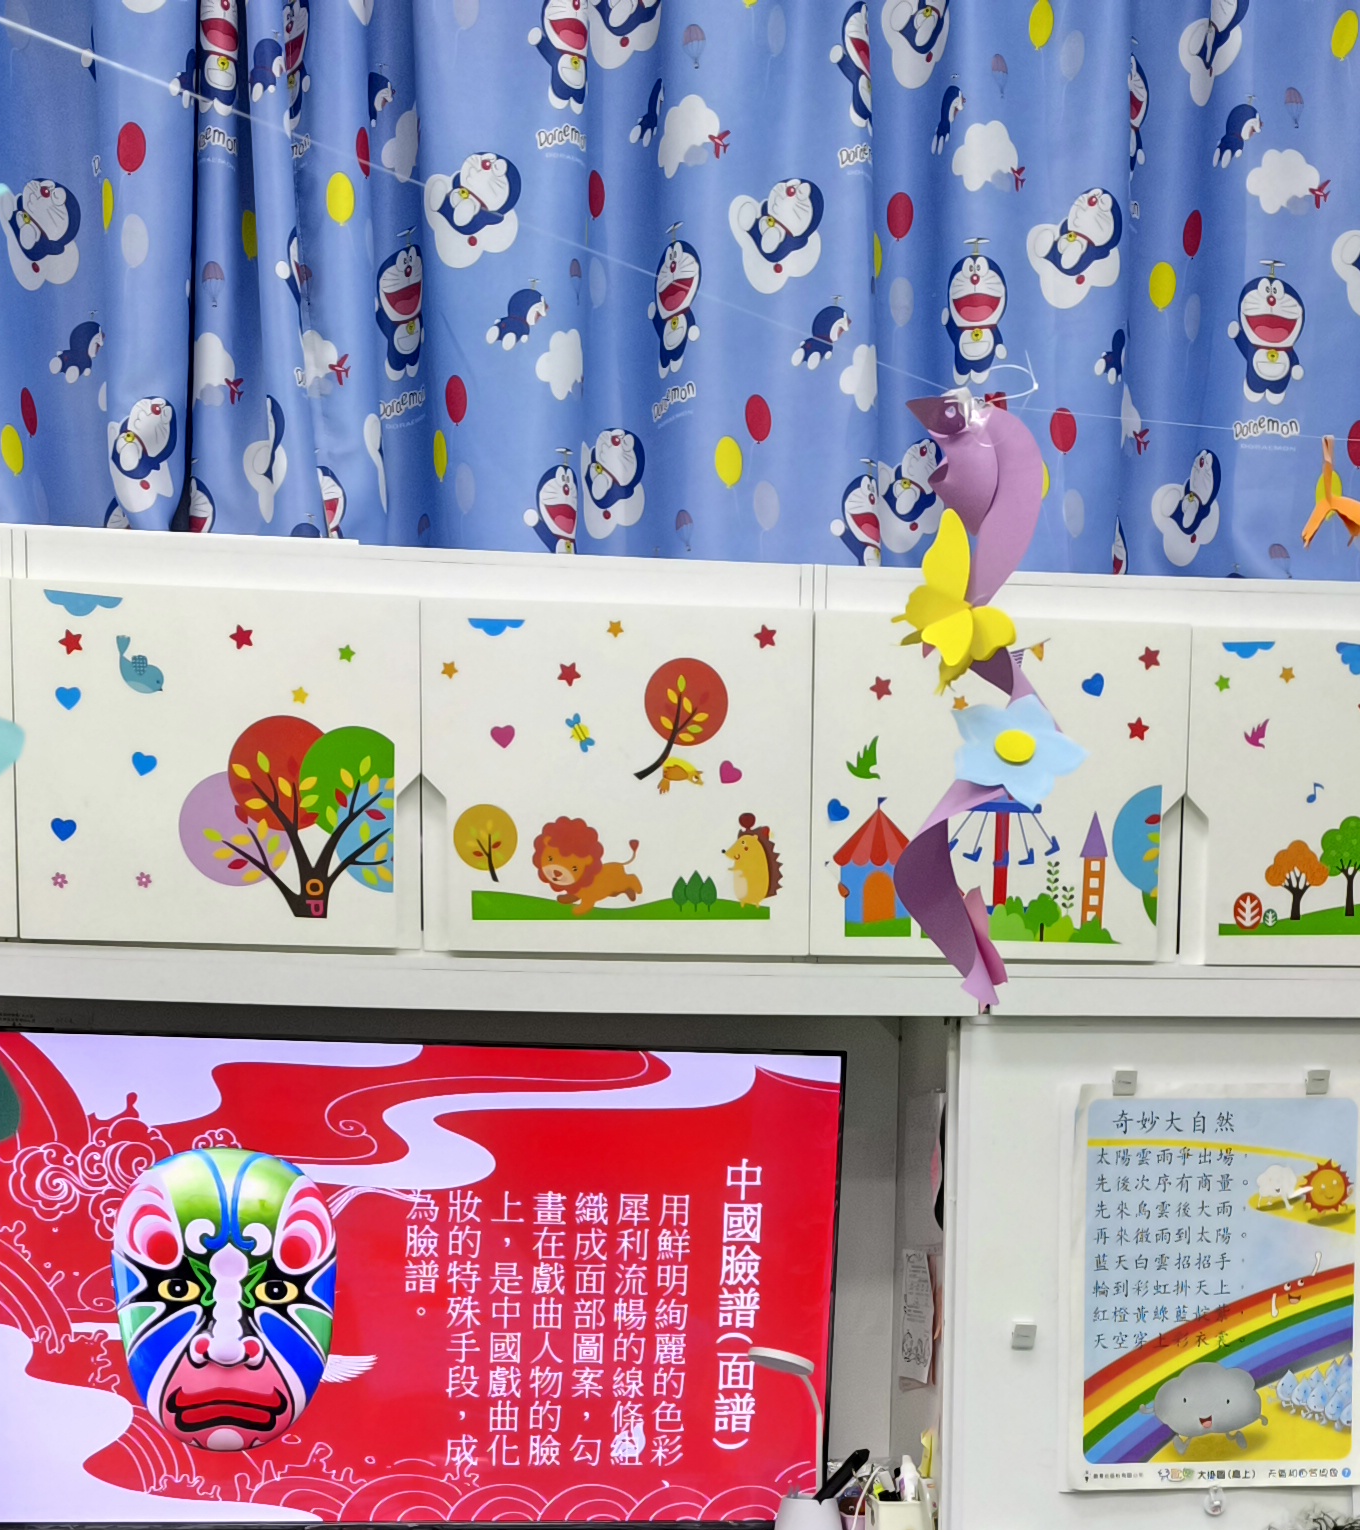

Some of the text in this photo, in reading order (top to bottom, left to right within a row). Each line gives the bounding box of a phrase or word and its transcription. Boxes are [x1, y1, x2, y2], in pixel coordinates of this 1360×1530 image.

[1234, 416, 1299, 438] Doraemon
[404, 1189, 440, 1317] 為臉譜。
[1095, 1173, 1249, 1193] 先後次序有商量。
[1112, 1109, 1236, 1135] 奇妙大自然
[444, 1189, 483, 1467] 妝的特殊手段，成
[486, 1190, 525, 1467] 上，是中國戲曲化
[528, 1190, 568, 1466] 畫在戲曲人物的臉
[569, 1191, 609, 1466] 織成面部圖案，勾
[610, 1193, 651, 1467] 犀利流暢的線條組
[650, 1193, 691, 1467] 用鮮明絢麗的色彩
[1093, 1252, 1245, 1271] 藍天白雲招招手，
